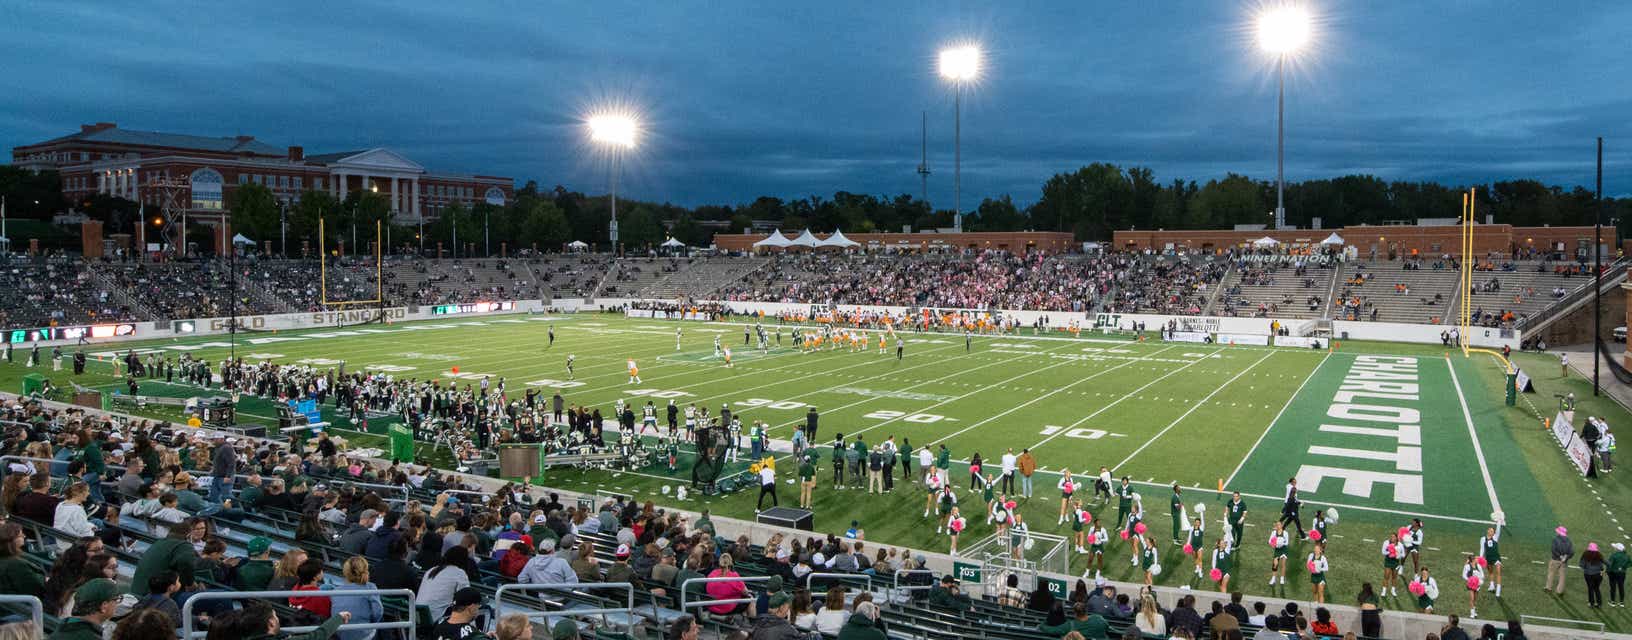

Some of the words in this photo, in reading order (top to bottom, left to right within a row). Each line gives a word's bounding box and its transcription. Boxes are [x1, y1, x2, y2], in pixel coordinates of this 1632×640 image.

[313, 309, 405, 324] STANDARD
[622, 388, 688, 398] 40
[733, 398, 807, 410] 30
[863, 410, 946, 424] 20
[1039, 425, 1108, 440] 10
[1295, 355, 1424, 505] CHARLOTTE
[1048, 582, 1060, 592] 02
